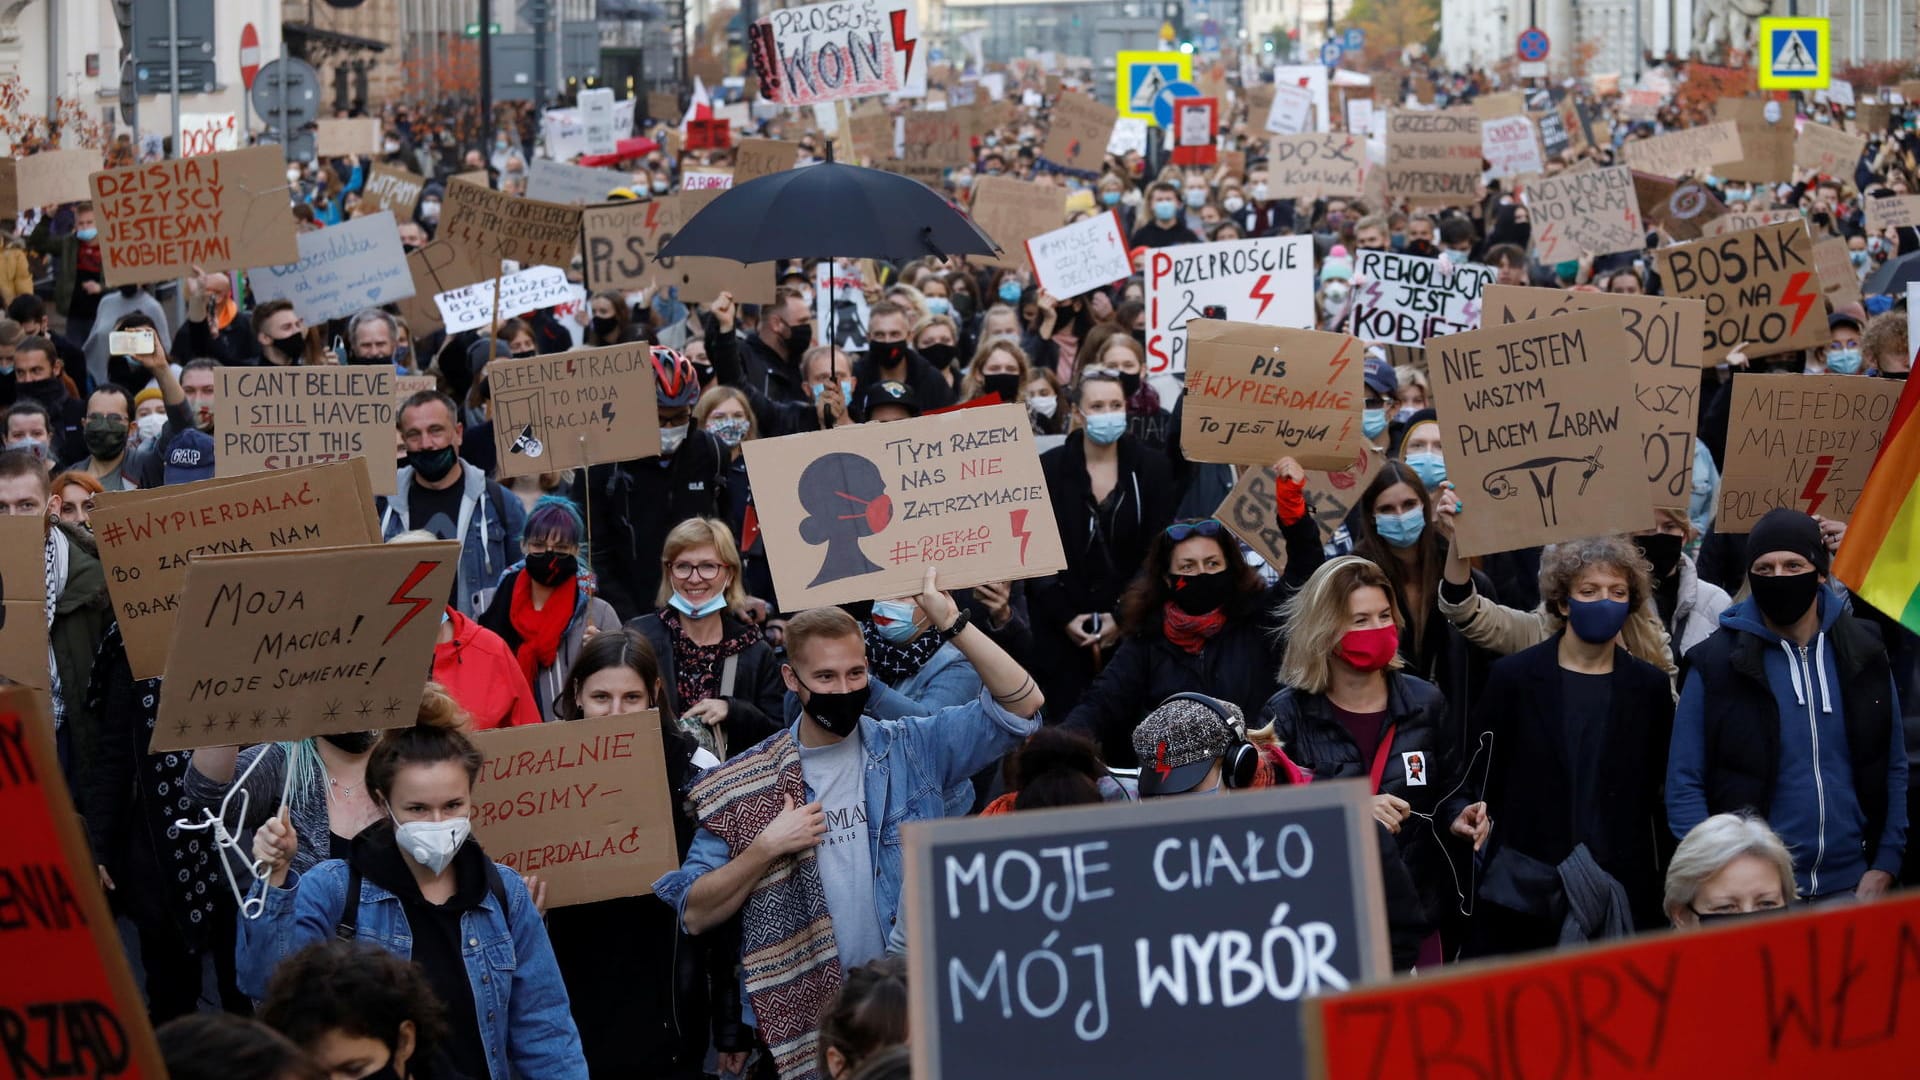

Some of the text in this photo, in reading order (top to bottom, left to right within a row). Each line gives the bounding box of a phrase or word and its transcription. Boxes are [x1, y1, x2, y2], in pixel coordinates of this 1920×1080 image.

[776, 30, 884, 97] WON
[97, 159, 219, 197] DZISIAJ
[1527, 166, 1632, 201] NO WOMEN
[100, 186, 224, 220] WSZYSCY
[1532, 202, 1566, 223] NO
[106, 211, 224, 243] JESTEŚMY
[110, 237, 232, 268] KOBIETAMI
[1152, 242, 1297, 291] PRZEPROŚCIE
[1668, 228, 1806, 293] BOSAK
[1363, 253, 1496, 300] REWOLUCJA
[443, 287, 474, 302] NIE
[1395, 286, 1454, 316] JEST
[1740, 283, 1771, 308] NA
[1704, 312, 1786, 349] SOLO
[1442, 328, 1588, 384] NIE JESTEM
[223, 374, 229, 397] I
[238, 372, 300, 397] CAN'T
[306, 372, 390, 396] BELIEVE
[551, 385, 618, 406] TO MOJA
[1464, 378, 1545, 412] WASZYM
[234, 405, 240, 425] I
[250, 404, 306, 425] STILL
[1200, 416, 1219, 433] TO
[1218, 420, 1274, 445] JEST
[1458, 402, 1620, 456] PLACEM ZABAW
[171, 448, 200, 465] GAP
[224, 432, 362, 456] PROTEST THIS
[886, 426, 1019, 467] TYM RAZEM
[1642, 424, 1692, 496] ÓJ
[1738, 428, 1786, 459] MA
[1795, 429, 1861, 455] LEPSZY
[901, 457, 1003, 492] NAS NIE
[903, 485, 1042, 521] ZATRZYMACIE
[112, 565, 141, 583] BO
[269, 524, 321, 548] NAM
[921, 541, 993, 563] KOBIET
[123, 594, 181, 620] BRAK
[204, 581, 305, 628] MOJA
[253, 614, 365, 665] MACICA!
[189, 656, 387, 702] MOJE SUMIENIE!
[821, 831, 857, 848] PARIS
[945, 823, 1314, 922] MOJE CIAŁO
[947, 902, 1353, 1042] MÓJ WYBÓR
[1337, 950, 1683, 1080] ZBIORY
